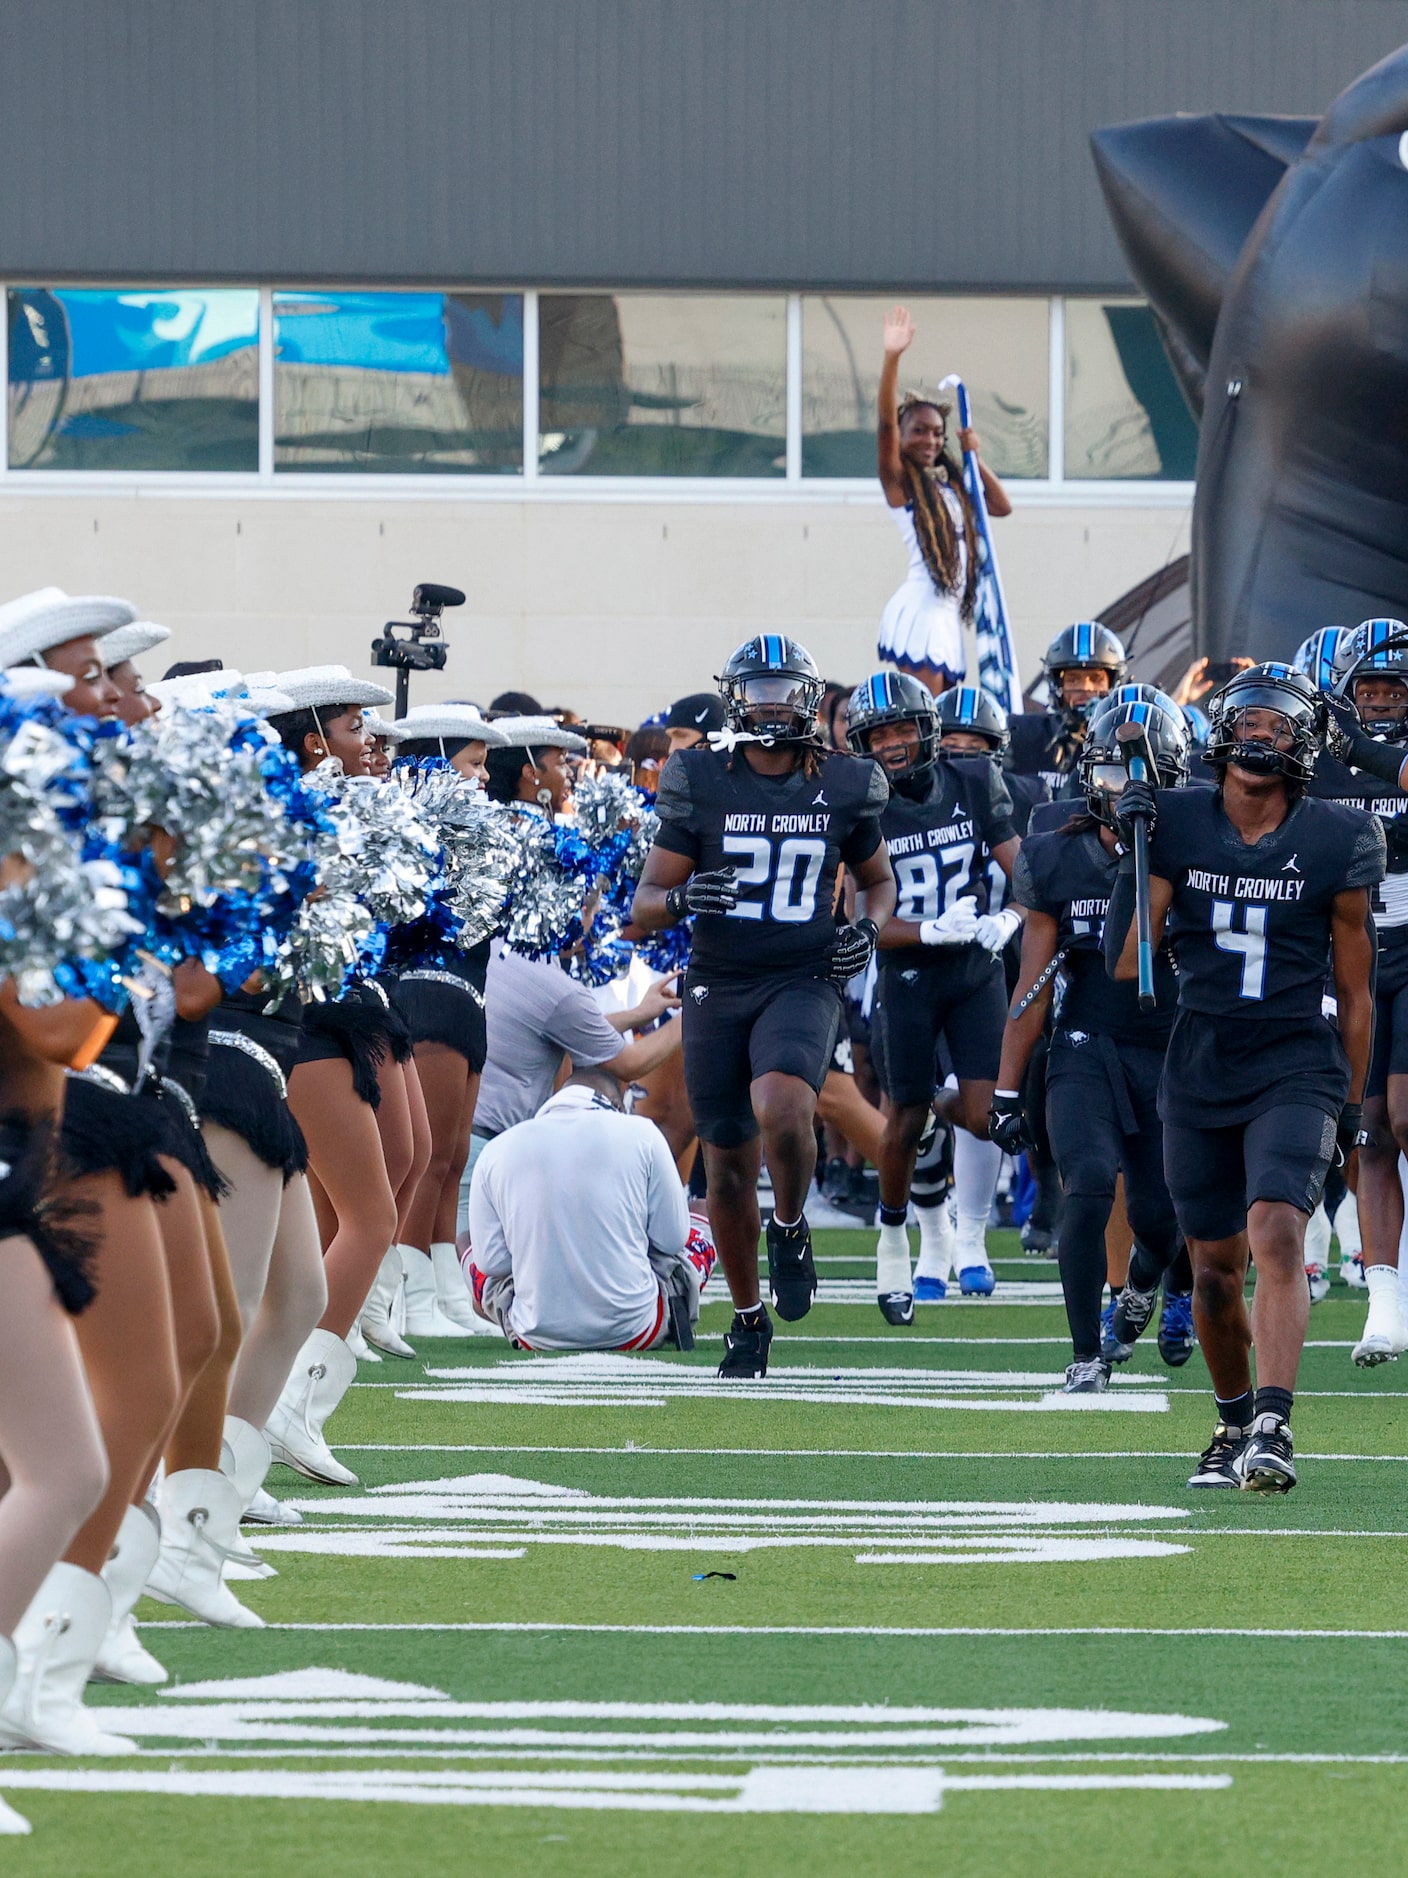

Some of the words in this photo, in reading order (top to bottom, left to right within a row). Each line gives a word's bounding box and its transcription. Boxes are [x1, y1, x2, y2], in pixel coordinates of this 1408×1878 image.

[724, 814, 767, 832] NORTH
[771, 814, 831, 833] CROWLEY
[887, 833, 924, 856] NORTH
[927, 820, 973, 847] CROWLEY
[722, 834, 828, 923] 20
[1186, 868, 1230, 896] NORTH
[1234, 876, 1305, 901] CROWLEY
[1071, 899, 1110, 917] NORTH
[1209, 899, 1269, 1000] 4
